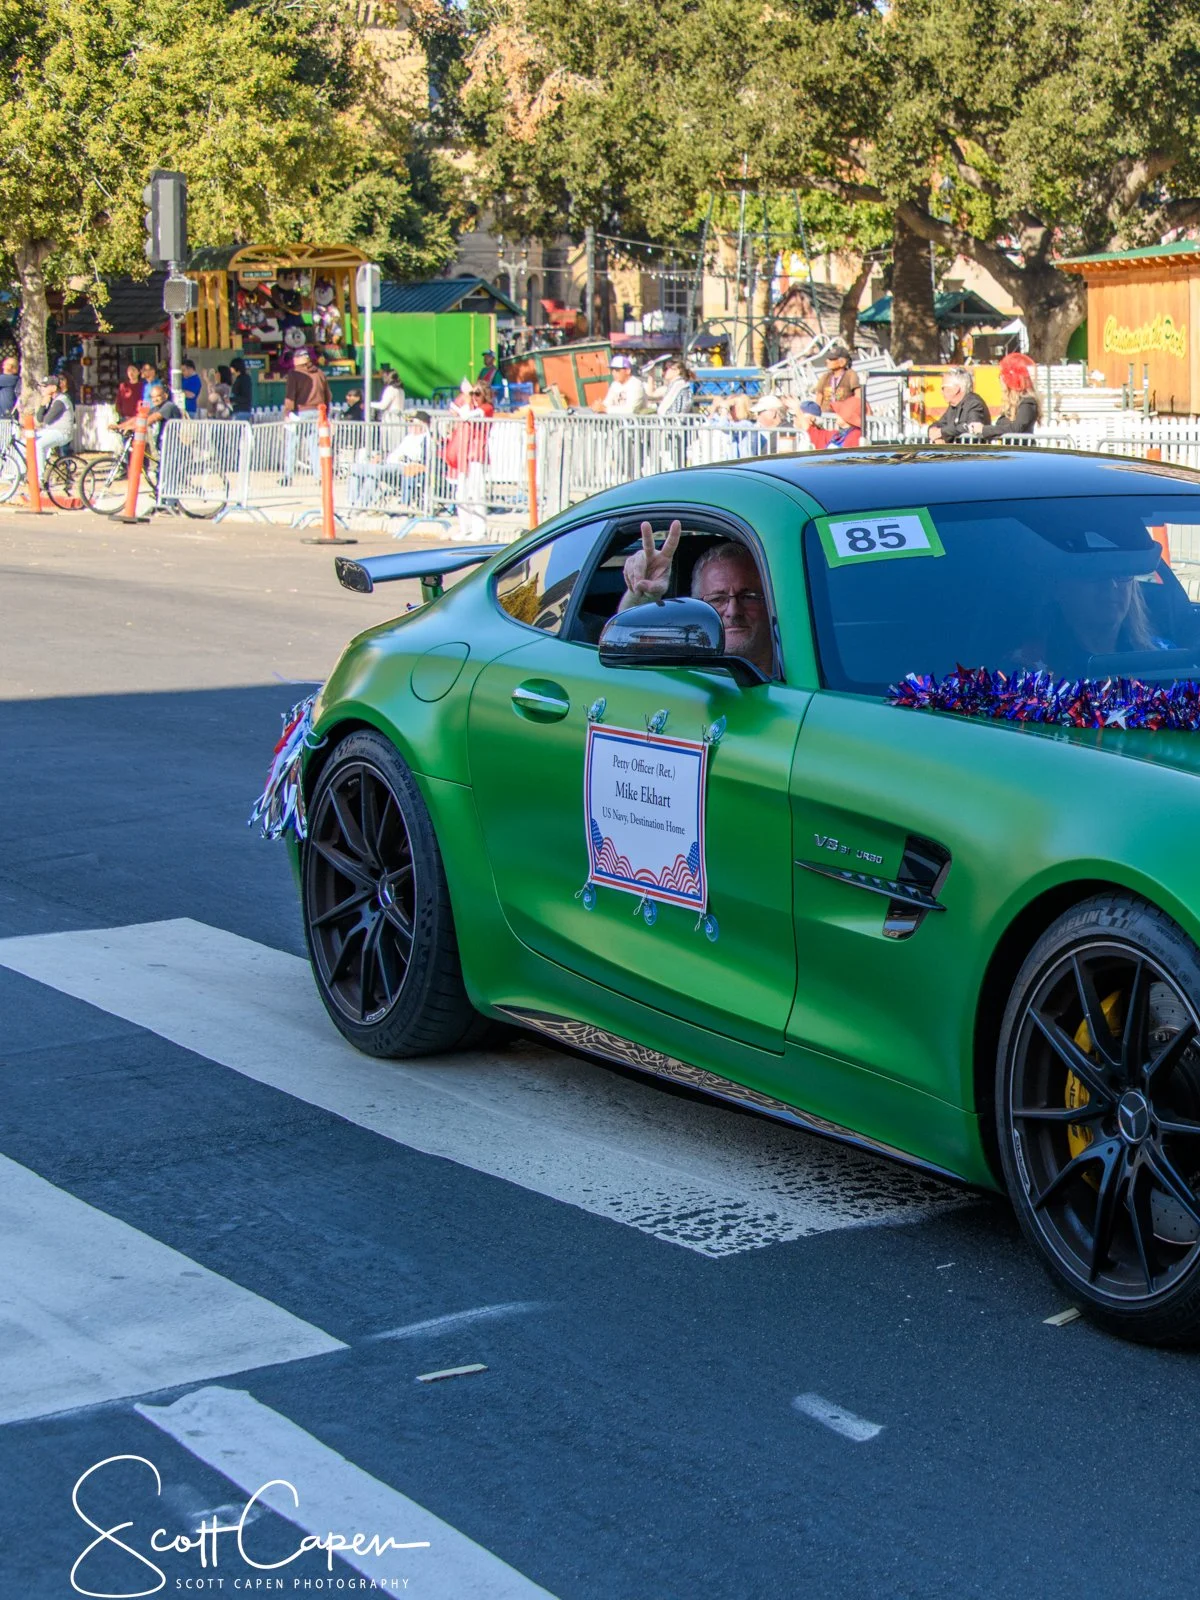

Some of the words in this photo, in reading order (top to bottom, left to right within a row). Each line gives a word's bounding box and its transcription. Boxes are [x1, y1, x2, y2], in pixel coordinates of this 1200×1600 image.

[845, 524, 907, 553] 85
[612, 754, 630, 774] Petty
[631, 758, 655, 775] Officer
[655, 763, 676, 780] (Ret.)
[615, 780, 638, 801] Mike
[640, 786, 671, 808] Ekhart
[602, 806, 611, 819] US
[612, 808, 629, 825] Navy,
[630, 812, 664, 831] Destination
[666, 820, 686, 835] Home
[814, 833, 839, 851] V8
[840, 845, 883, 864] BIURBO
